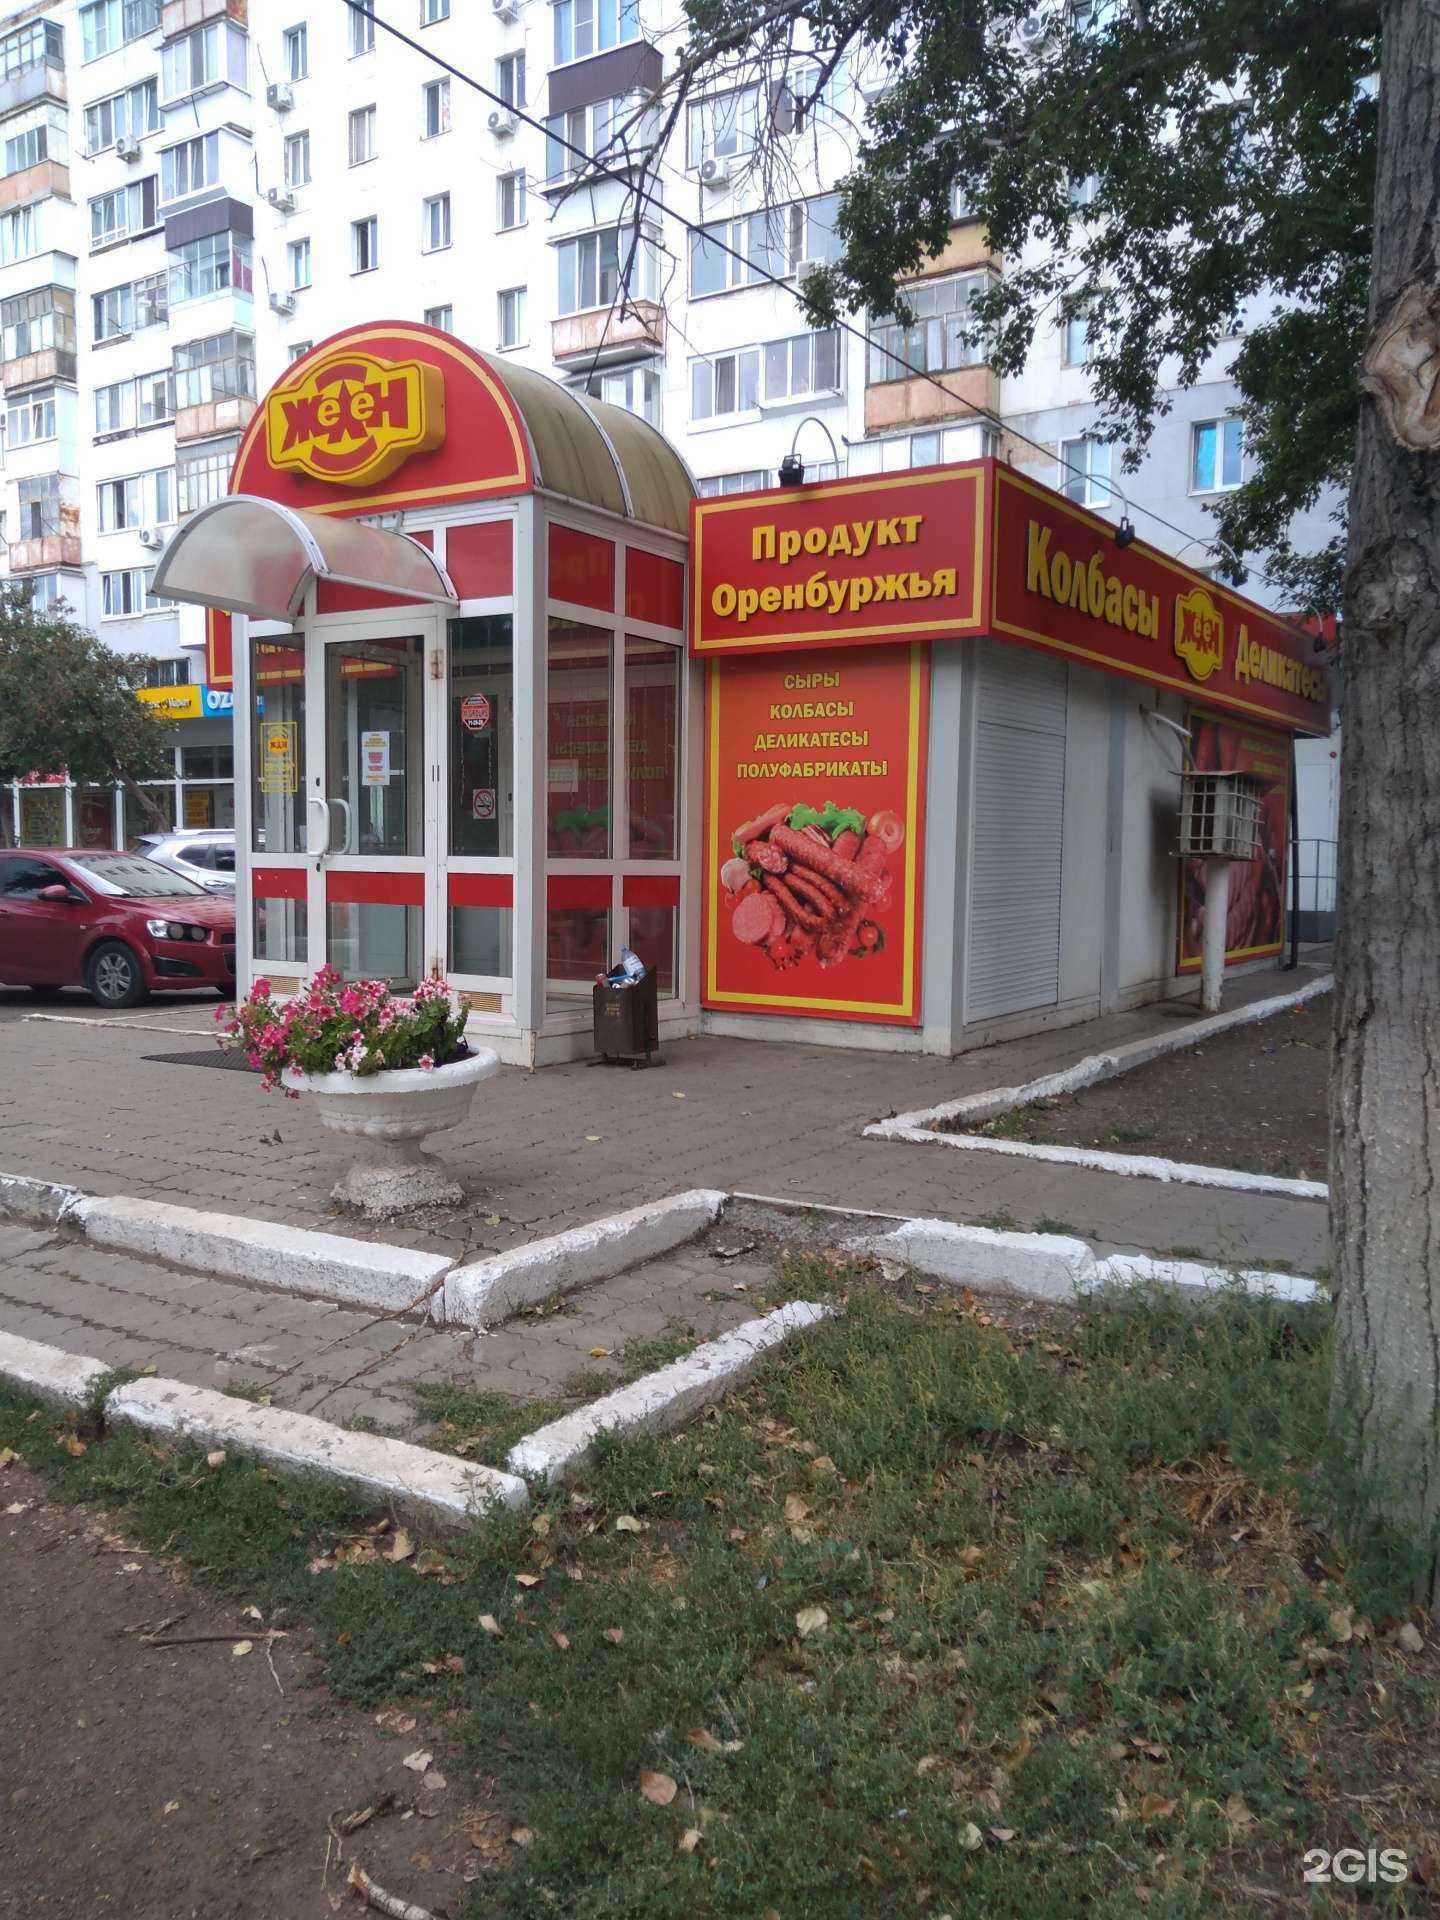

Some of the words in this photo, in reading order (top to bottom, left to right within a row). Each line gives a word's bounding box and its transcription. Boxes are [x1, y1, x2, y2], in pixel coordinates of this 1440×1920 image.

[752, 515, 922, 564] Продукт
[1027, 519, 1159, 640] Колбасы
[711, 568, 957, 622] Оренбуржья
[784, 671, 841, 690] СЫРЫ
[770, 701, 855, 720] КОЛБАСЫ
[754, 730, 869, 752] ДЕЛИКАТЕСЫ
[736, 760, 888, 779] ПОЛУФАБРИКАТЫ
